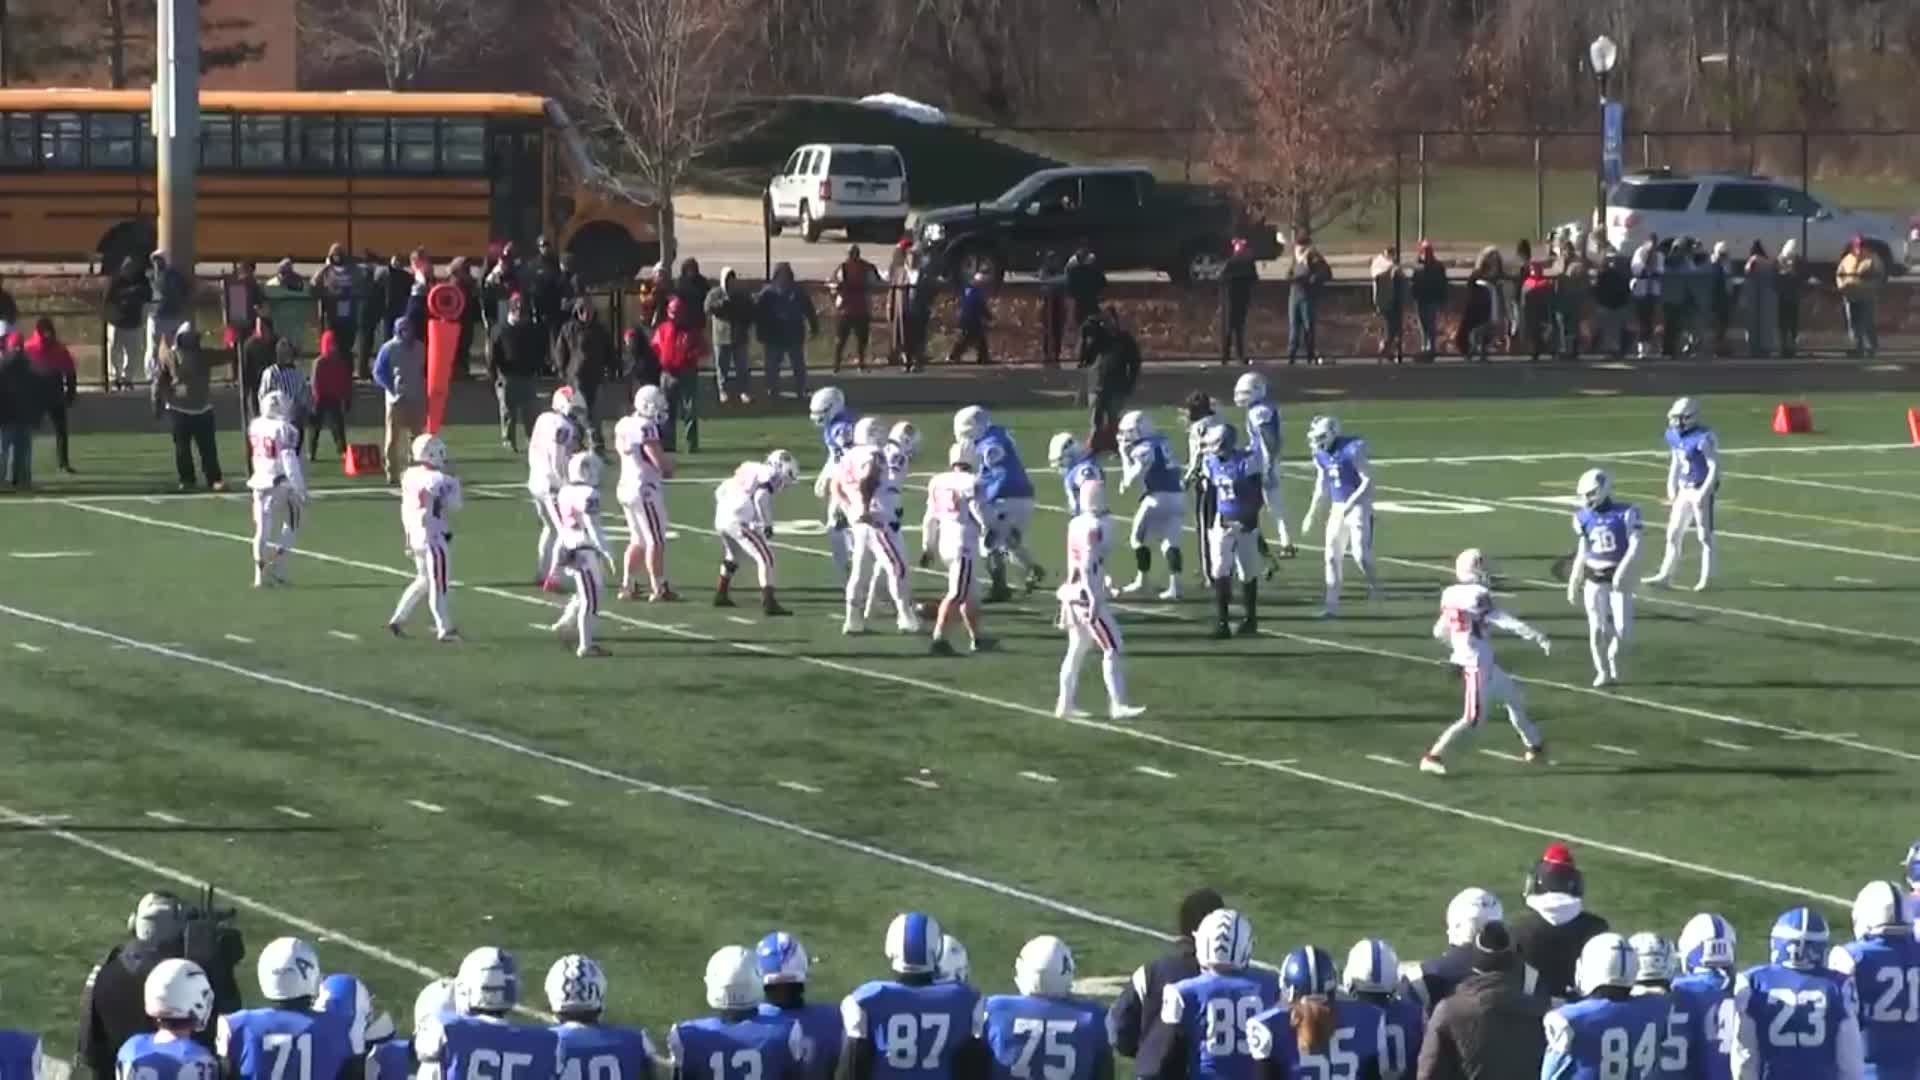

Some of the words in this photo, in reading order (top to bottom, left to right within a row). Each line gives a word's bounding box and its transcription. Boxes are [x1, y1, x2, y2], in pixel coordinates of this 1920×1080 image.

[1768, 988, 1826, 1046] 23
[1872, 966, 1920, 1022] 21
[887, 1013, 950, 1069] 87
[1011, 1018, 1076, 1080] 75
[1207, 996, 1264, 1056] 89
[263, 1033, 313, 1080] 71
